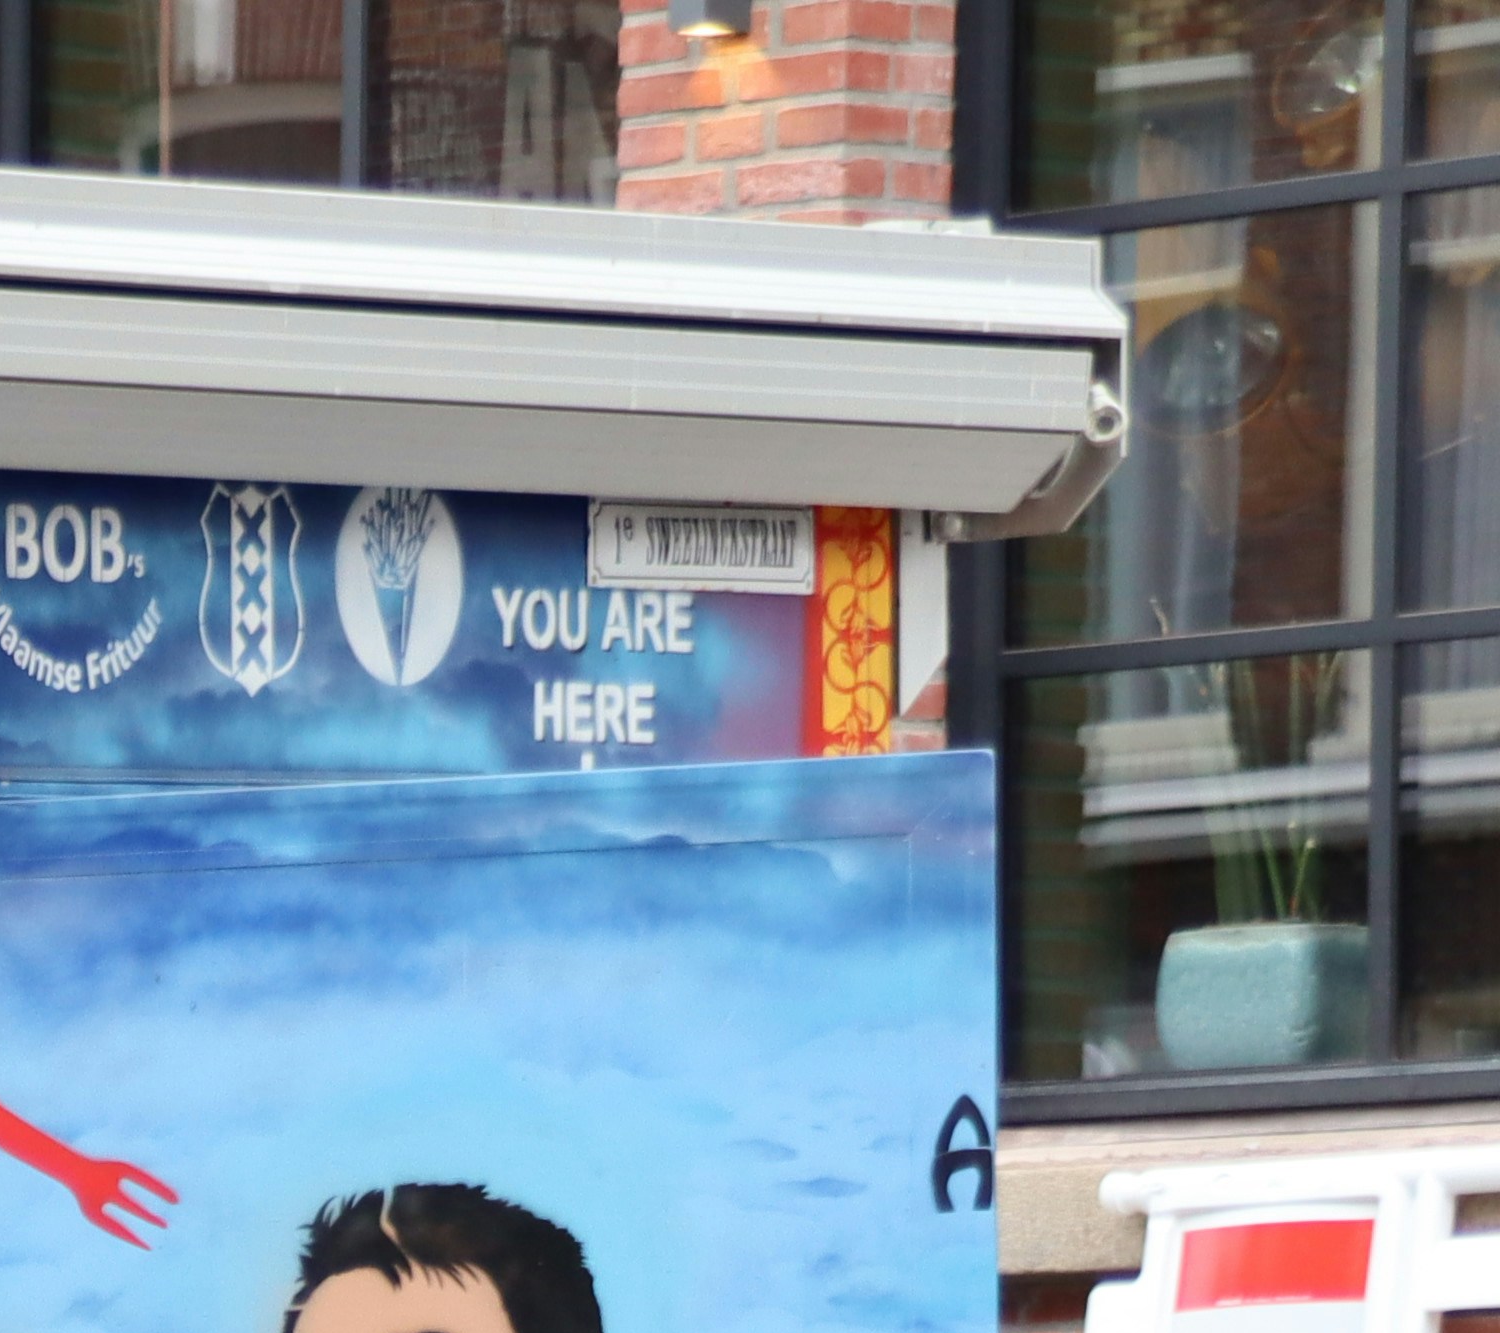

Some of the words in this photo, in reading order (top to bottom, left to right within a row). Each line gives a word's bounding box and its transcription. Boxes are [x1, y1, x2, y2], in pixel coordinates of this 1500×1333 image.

[87, 598, 163, 690] Frituur
[491, 586, 589, 652] YOU
[602, 592, 696, 655] ARE
[533, 680, 656, 745] HERE
